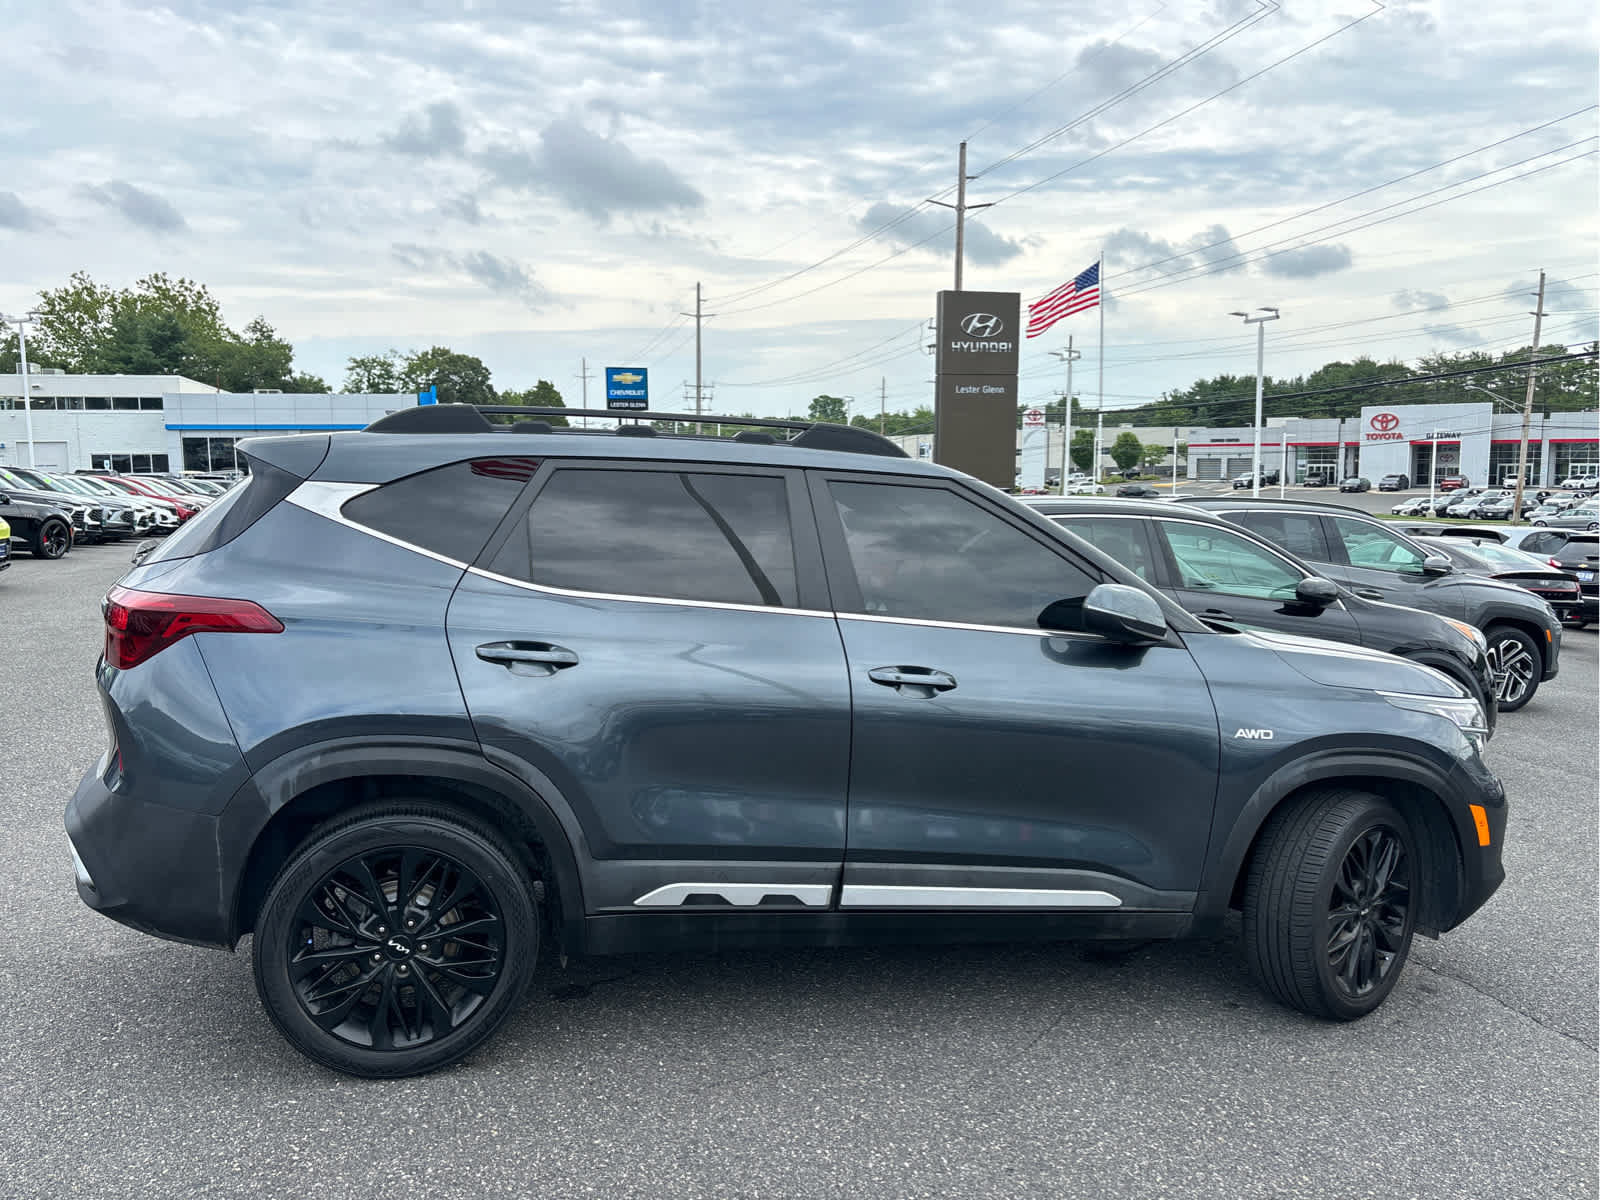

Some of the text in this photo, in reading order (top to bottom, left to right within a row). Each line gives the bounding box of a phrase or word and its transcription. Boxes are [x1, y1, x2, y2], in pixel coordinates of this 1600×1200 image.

[951, 341, 1012, 352] HYUNDAI
[955, 385, 1005, 393] Lester Glenn
[1365, 432, 1404, 440] TOYOTA
[1234, 728, 1273, 739] AWD
